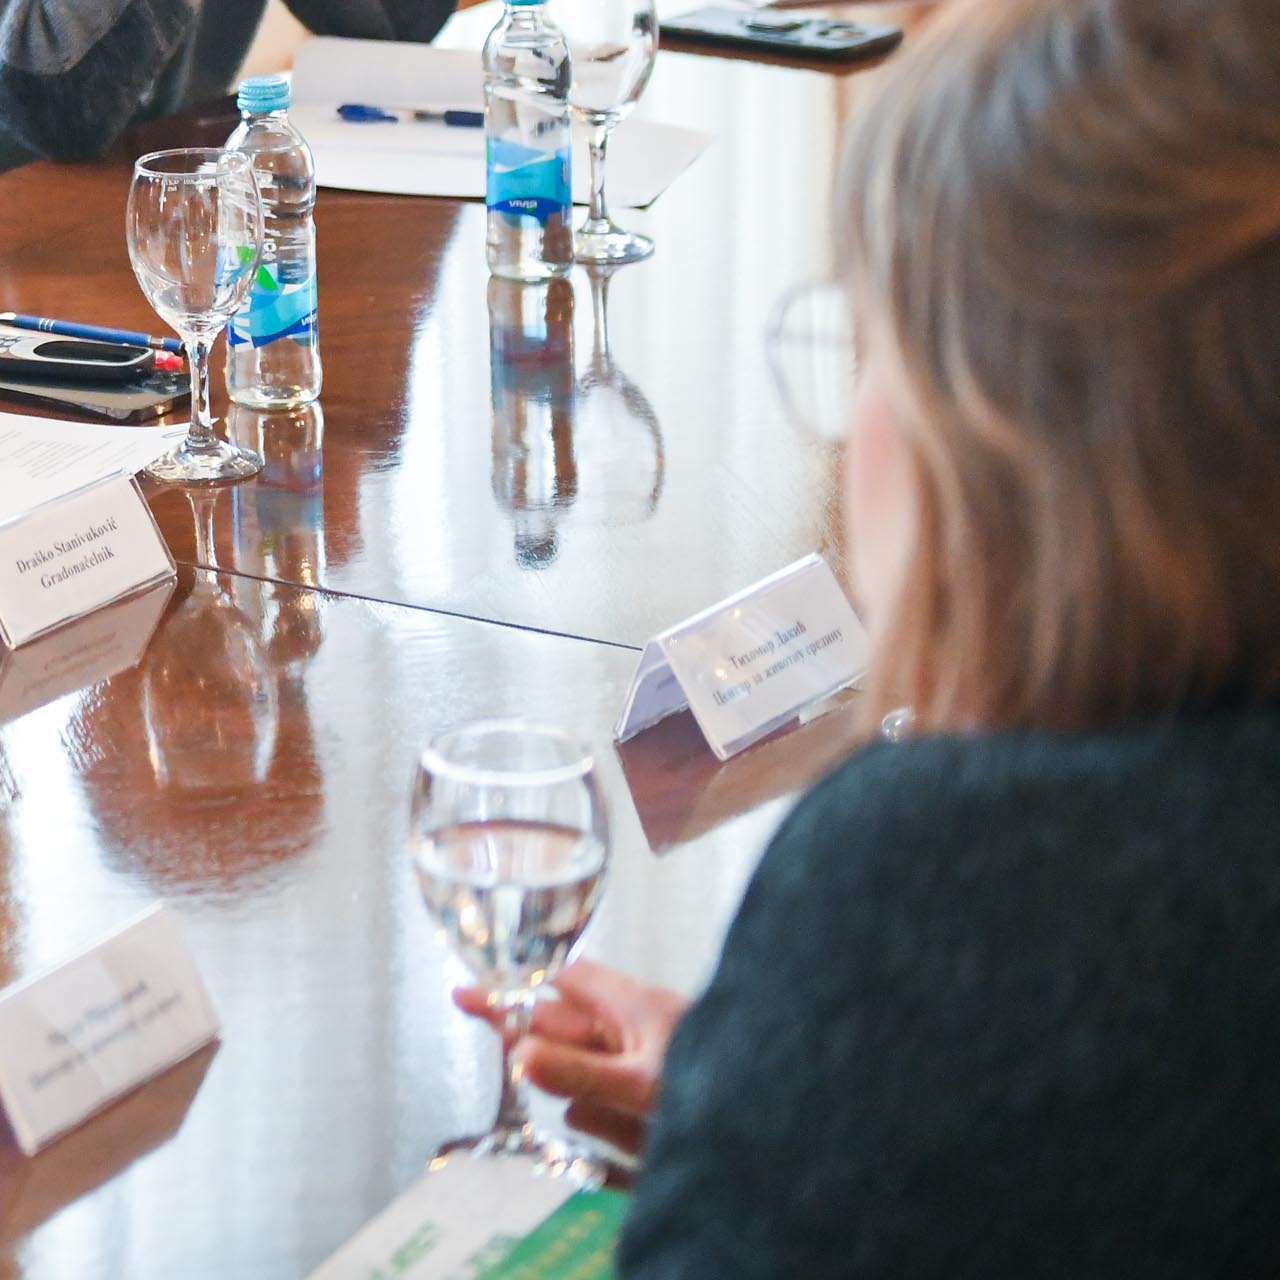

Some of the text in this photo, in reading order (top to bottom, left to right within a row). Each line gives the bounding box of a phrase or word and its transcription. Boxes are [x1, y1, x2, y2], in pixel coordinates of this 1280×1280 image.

[16, 517, 118, 574] Draško Stanivuković
[40, 545, 115, 589] Gradonačelnik
[712, 679, 752, 706] Ценр
